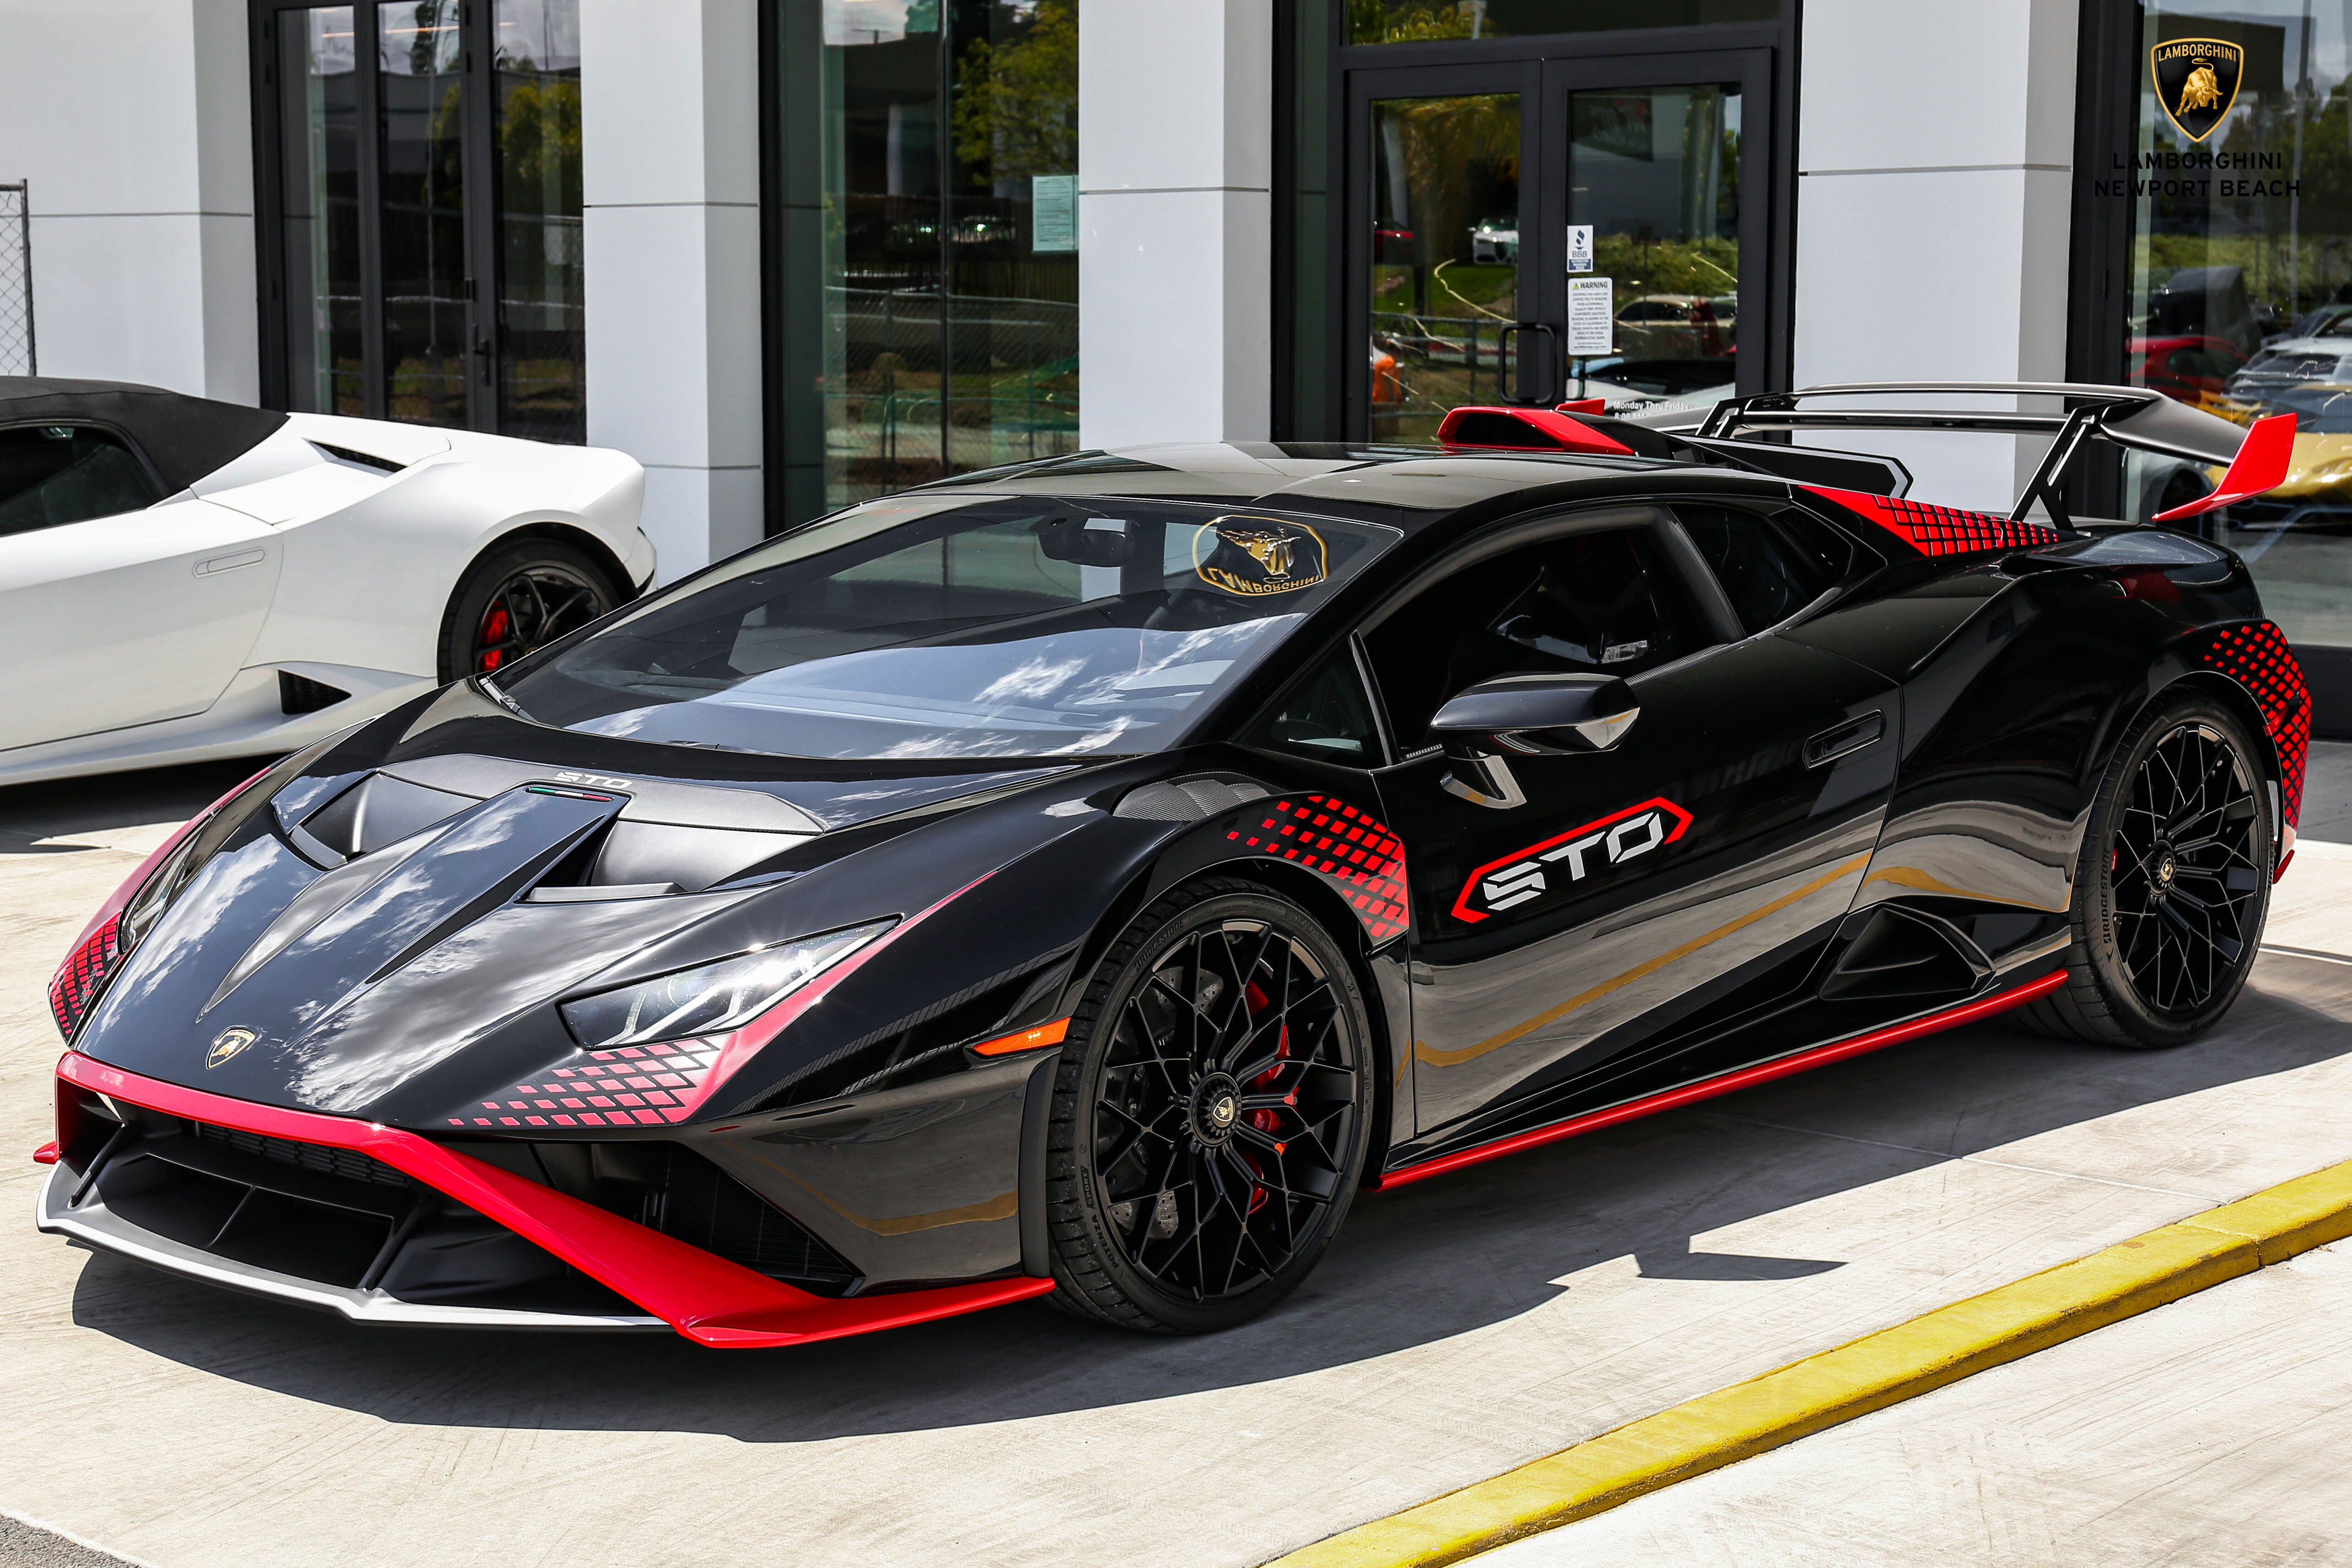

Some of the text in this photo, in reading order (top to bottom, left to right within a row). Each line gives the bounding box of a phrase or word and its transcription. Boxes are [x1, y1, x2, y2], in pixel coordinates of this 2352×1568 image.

[1614, 401, 1644, 411] Monday
[1645, 401, 1663, 410] Thru
[554, 771, 633, 789] STO
[1483, 812, 1663, 911] STO
[2100, 845, 2112, 944] BRIDGESTONE
[1133, 919, 1185, 972] BRIDGESTONE
[1083, 1173, 1091, 1205] SPORT
[1091, 1213, 1120, 1269] POTENZA
